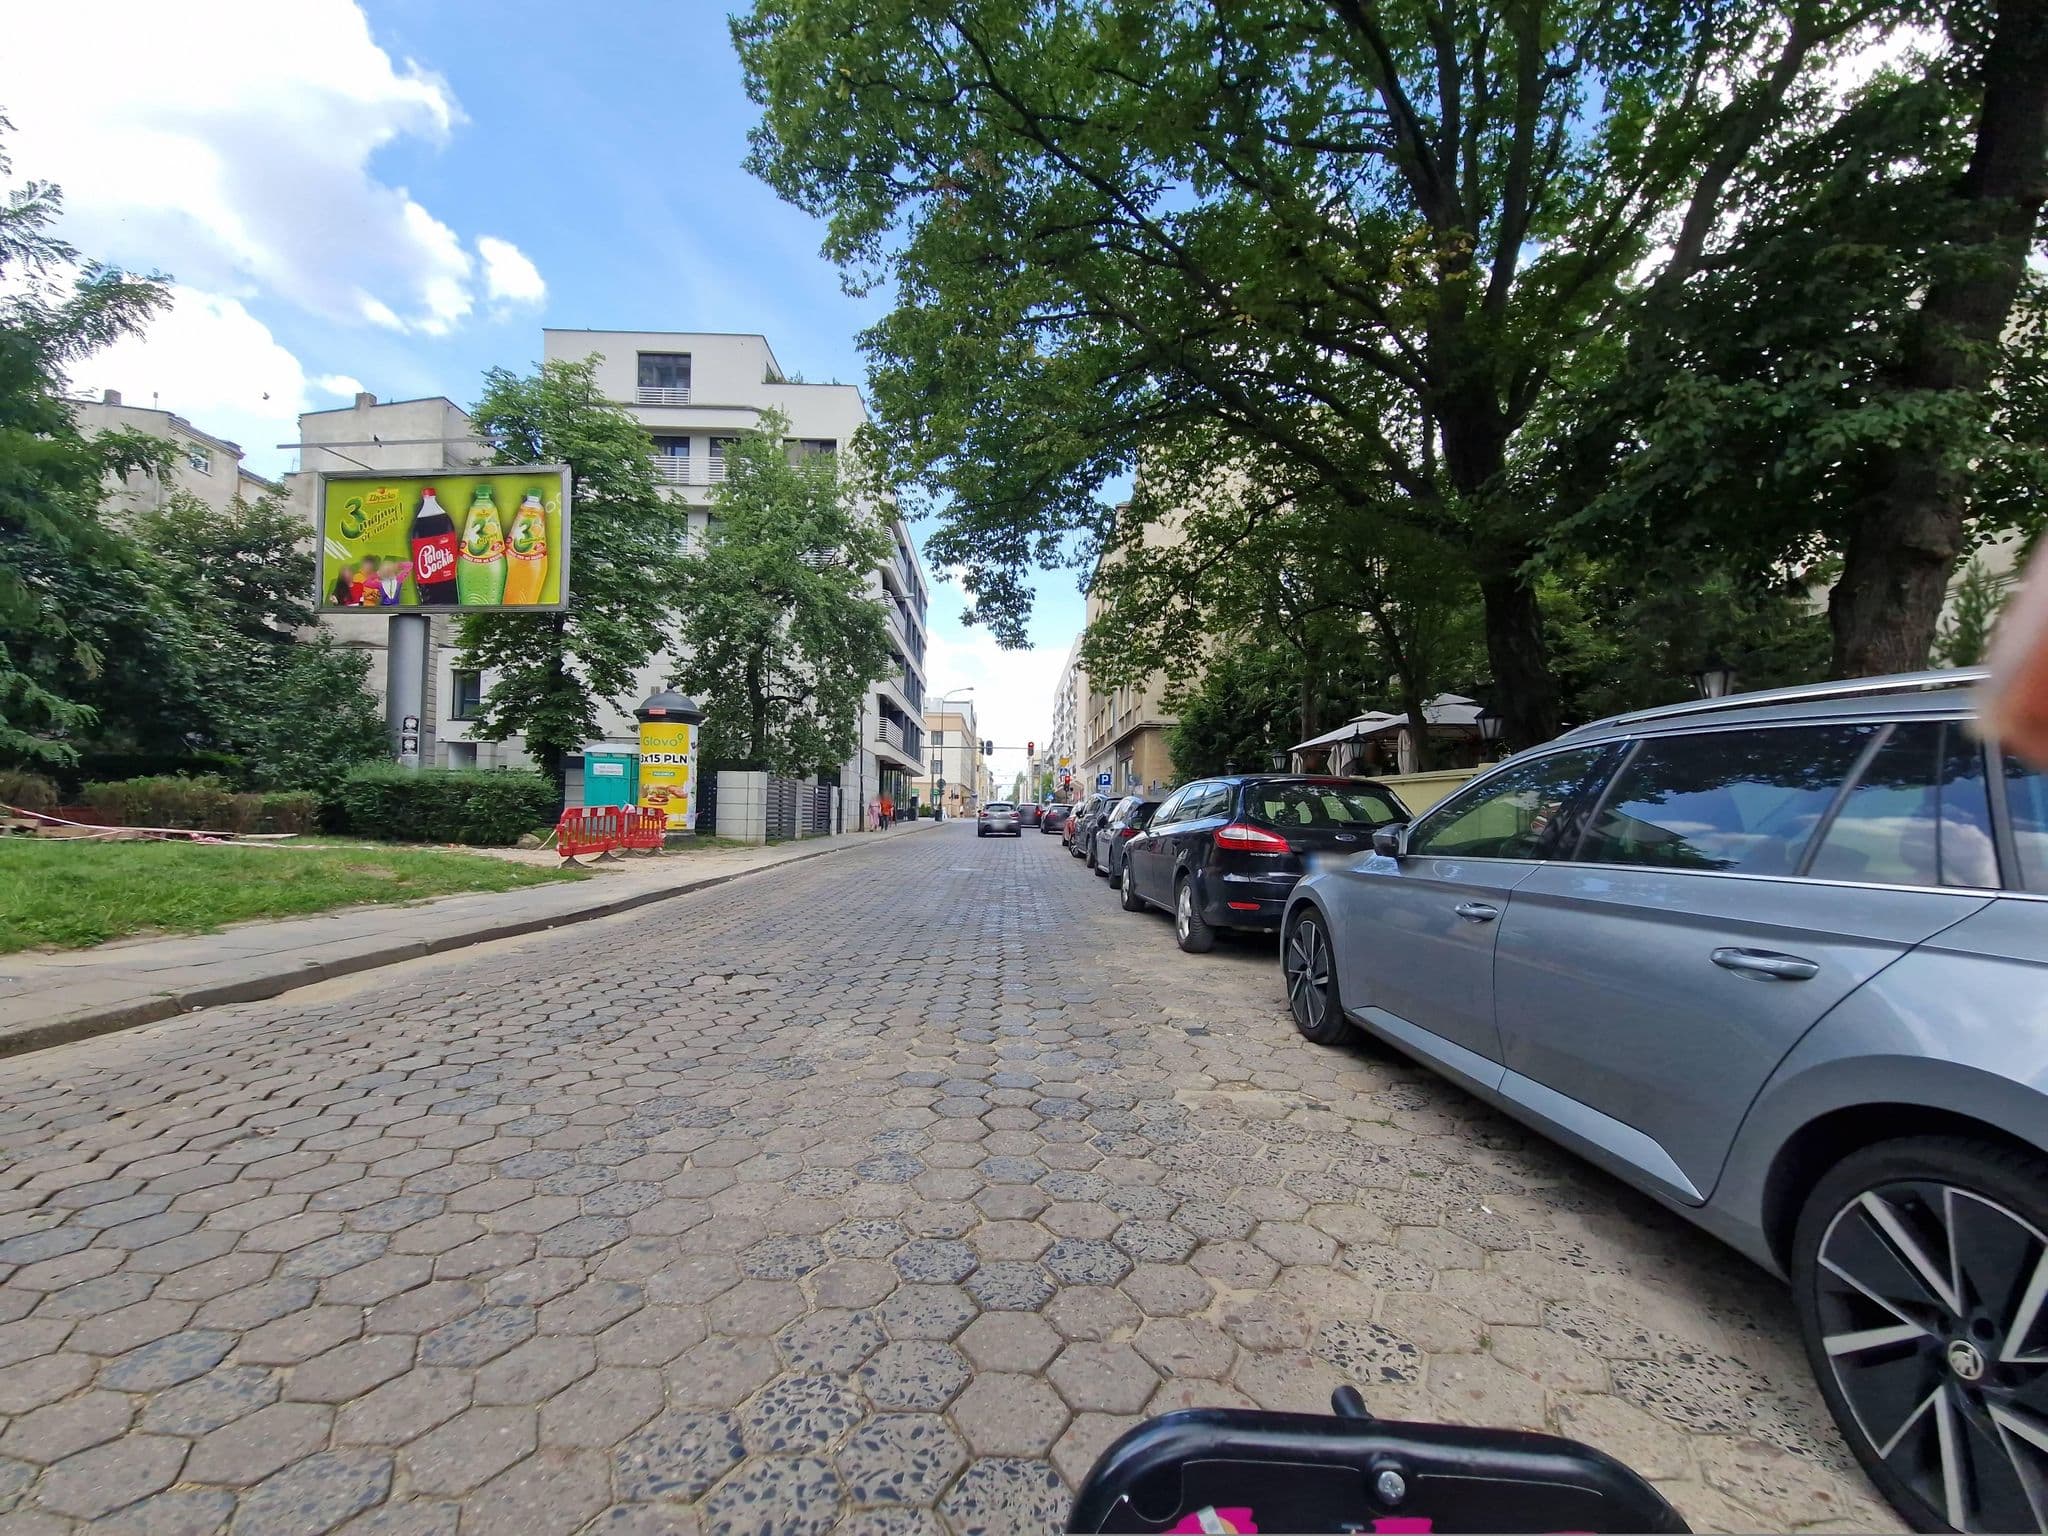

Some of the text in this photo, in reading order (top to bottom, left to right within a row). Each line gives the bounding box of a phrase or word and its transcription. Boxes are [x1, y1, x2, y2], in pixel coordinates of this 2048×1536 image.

[643, 736, 678, 747] Glovo
[664, 754, 688, 764] PLN
[1102, 775, 1109, 784] P
